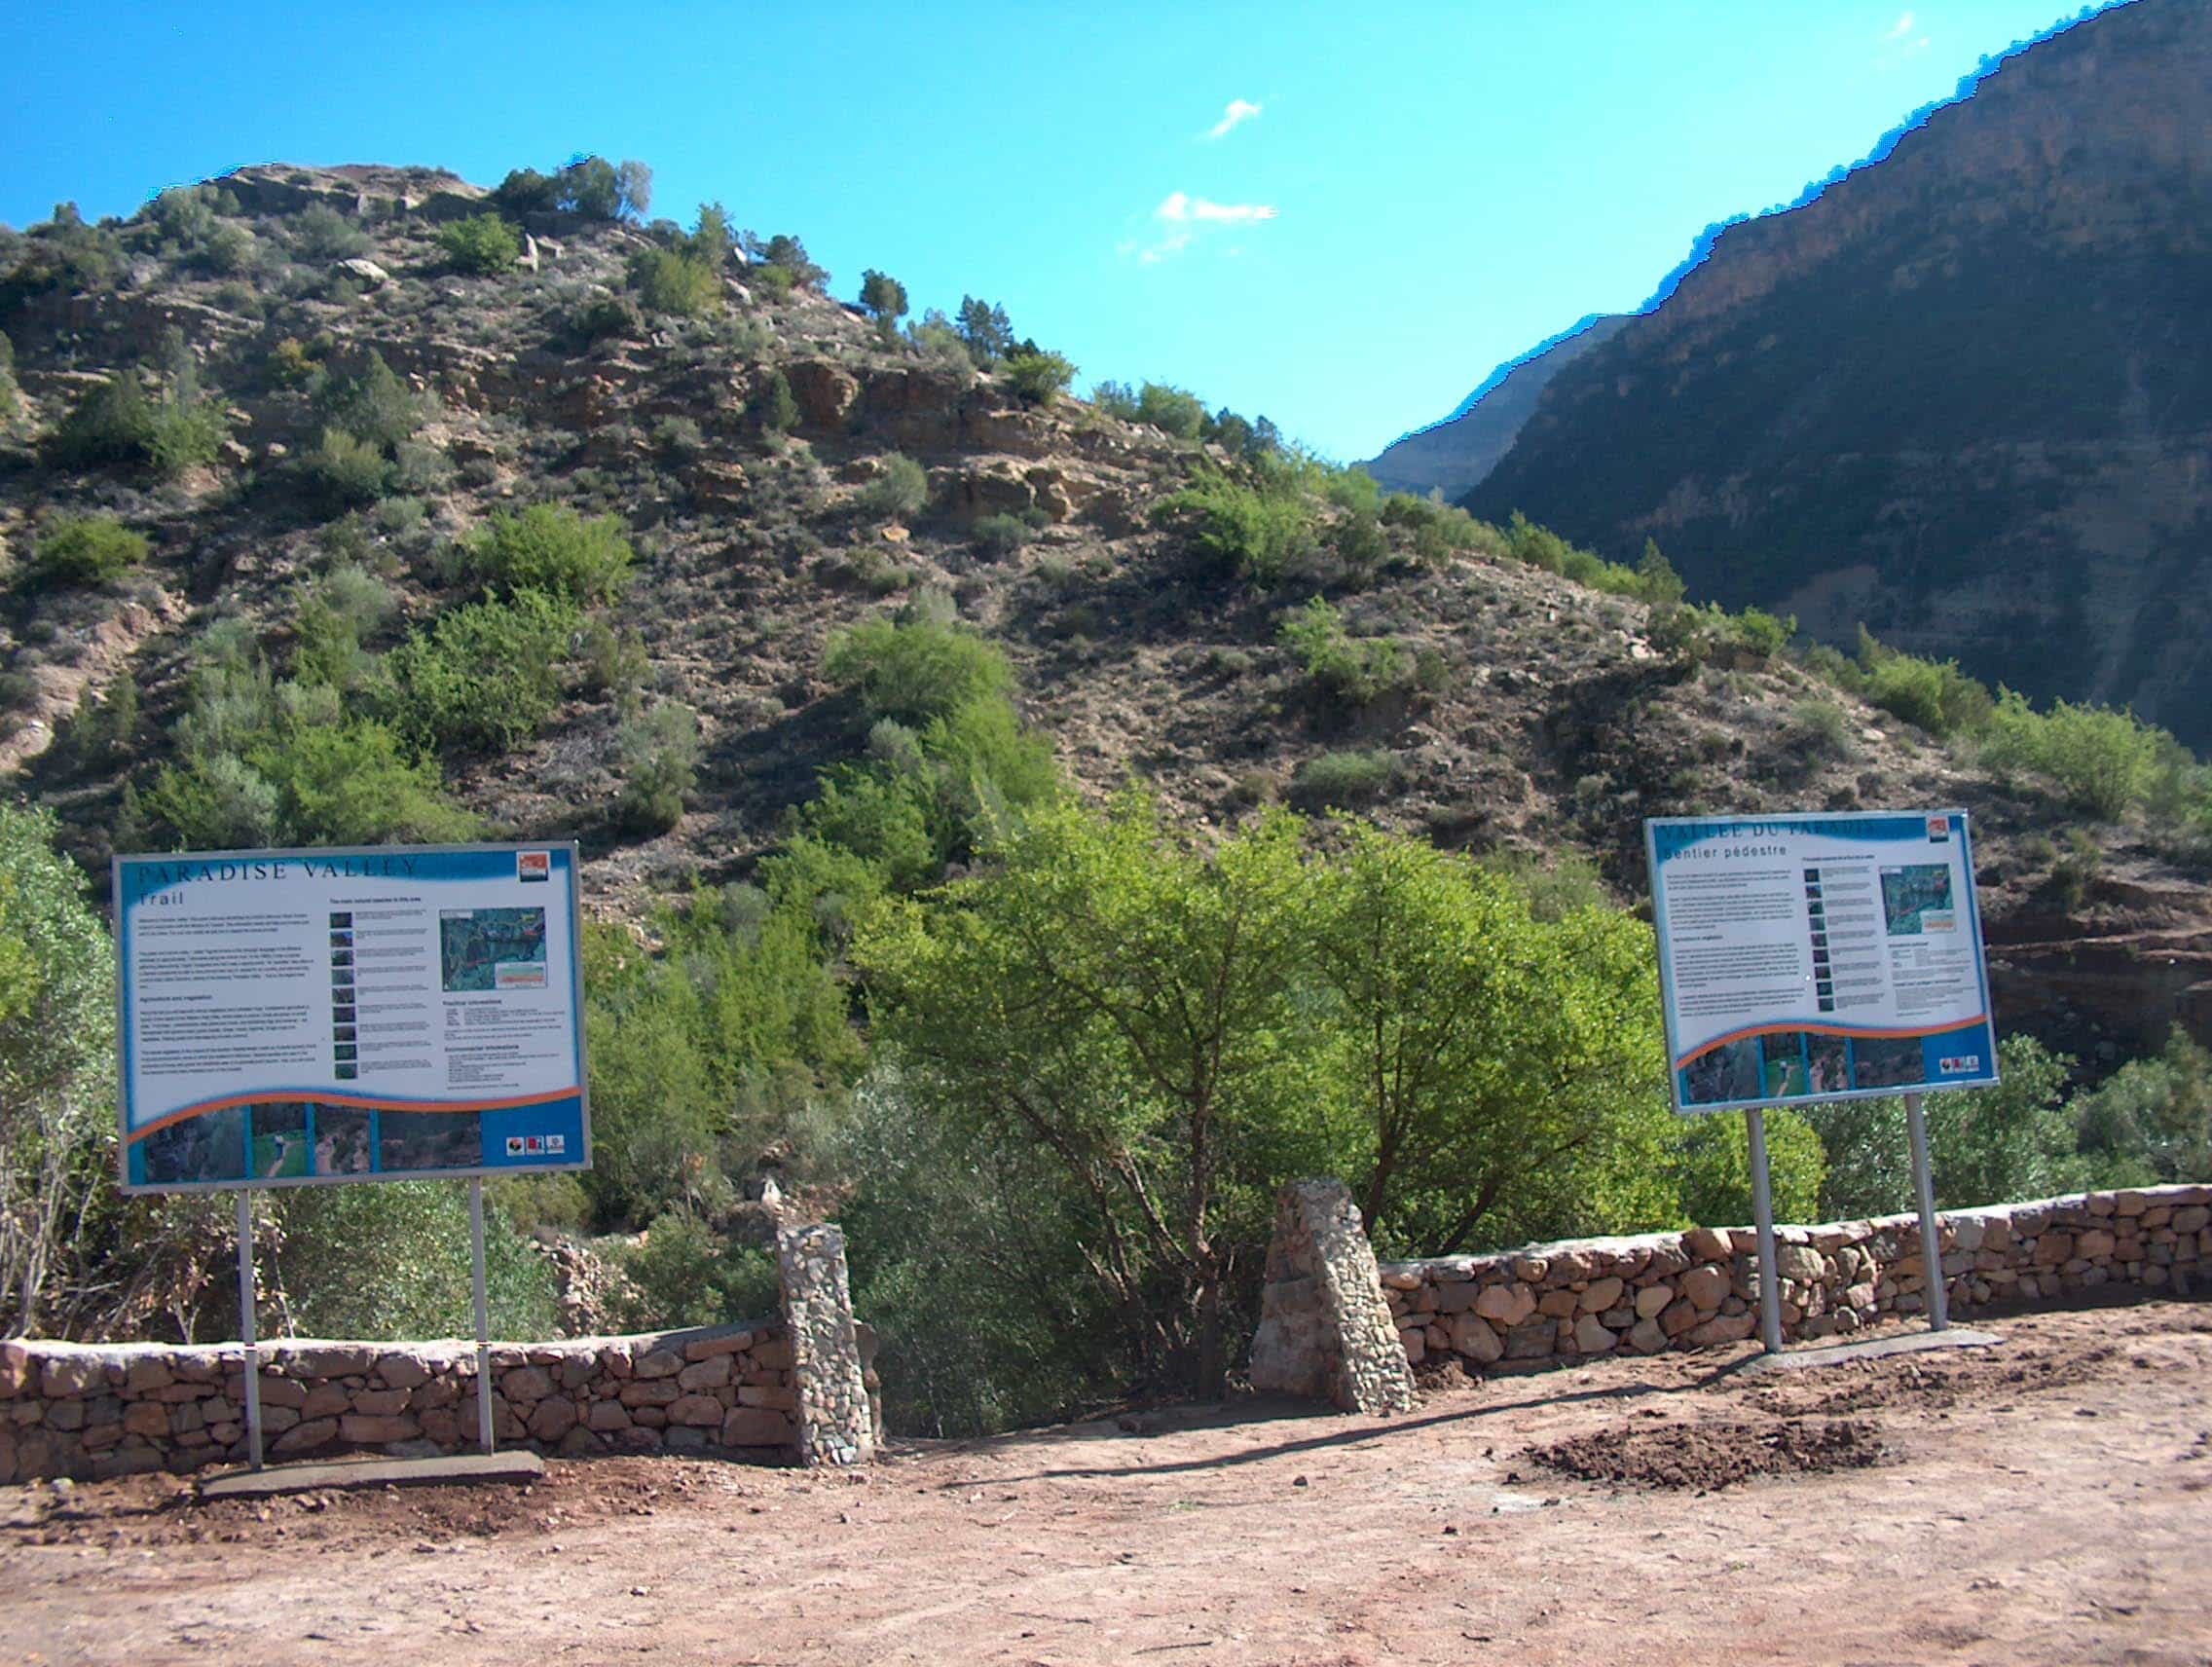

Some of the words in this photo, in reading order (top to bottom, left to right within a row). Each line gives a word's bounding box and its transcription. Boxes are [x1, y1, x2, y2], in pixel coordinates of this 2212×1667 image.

[1752, 823, 1779, 837] DU
[1665, 847, 1717, 860] Sentier
[1724, 844, 1788, 859] pédestre
[137, 861, 288, 884] PARADISE
[303, 857, 424, 878] VALLEY
[138, 891, 185, 907] Trail
